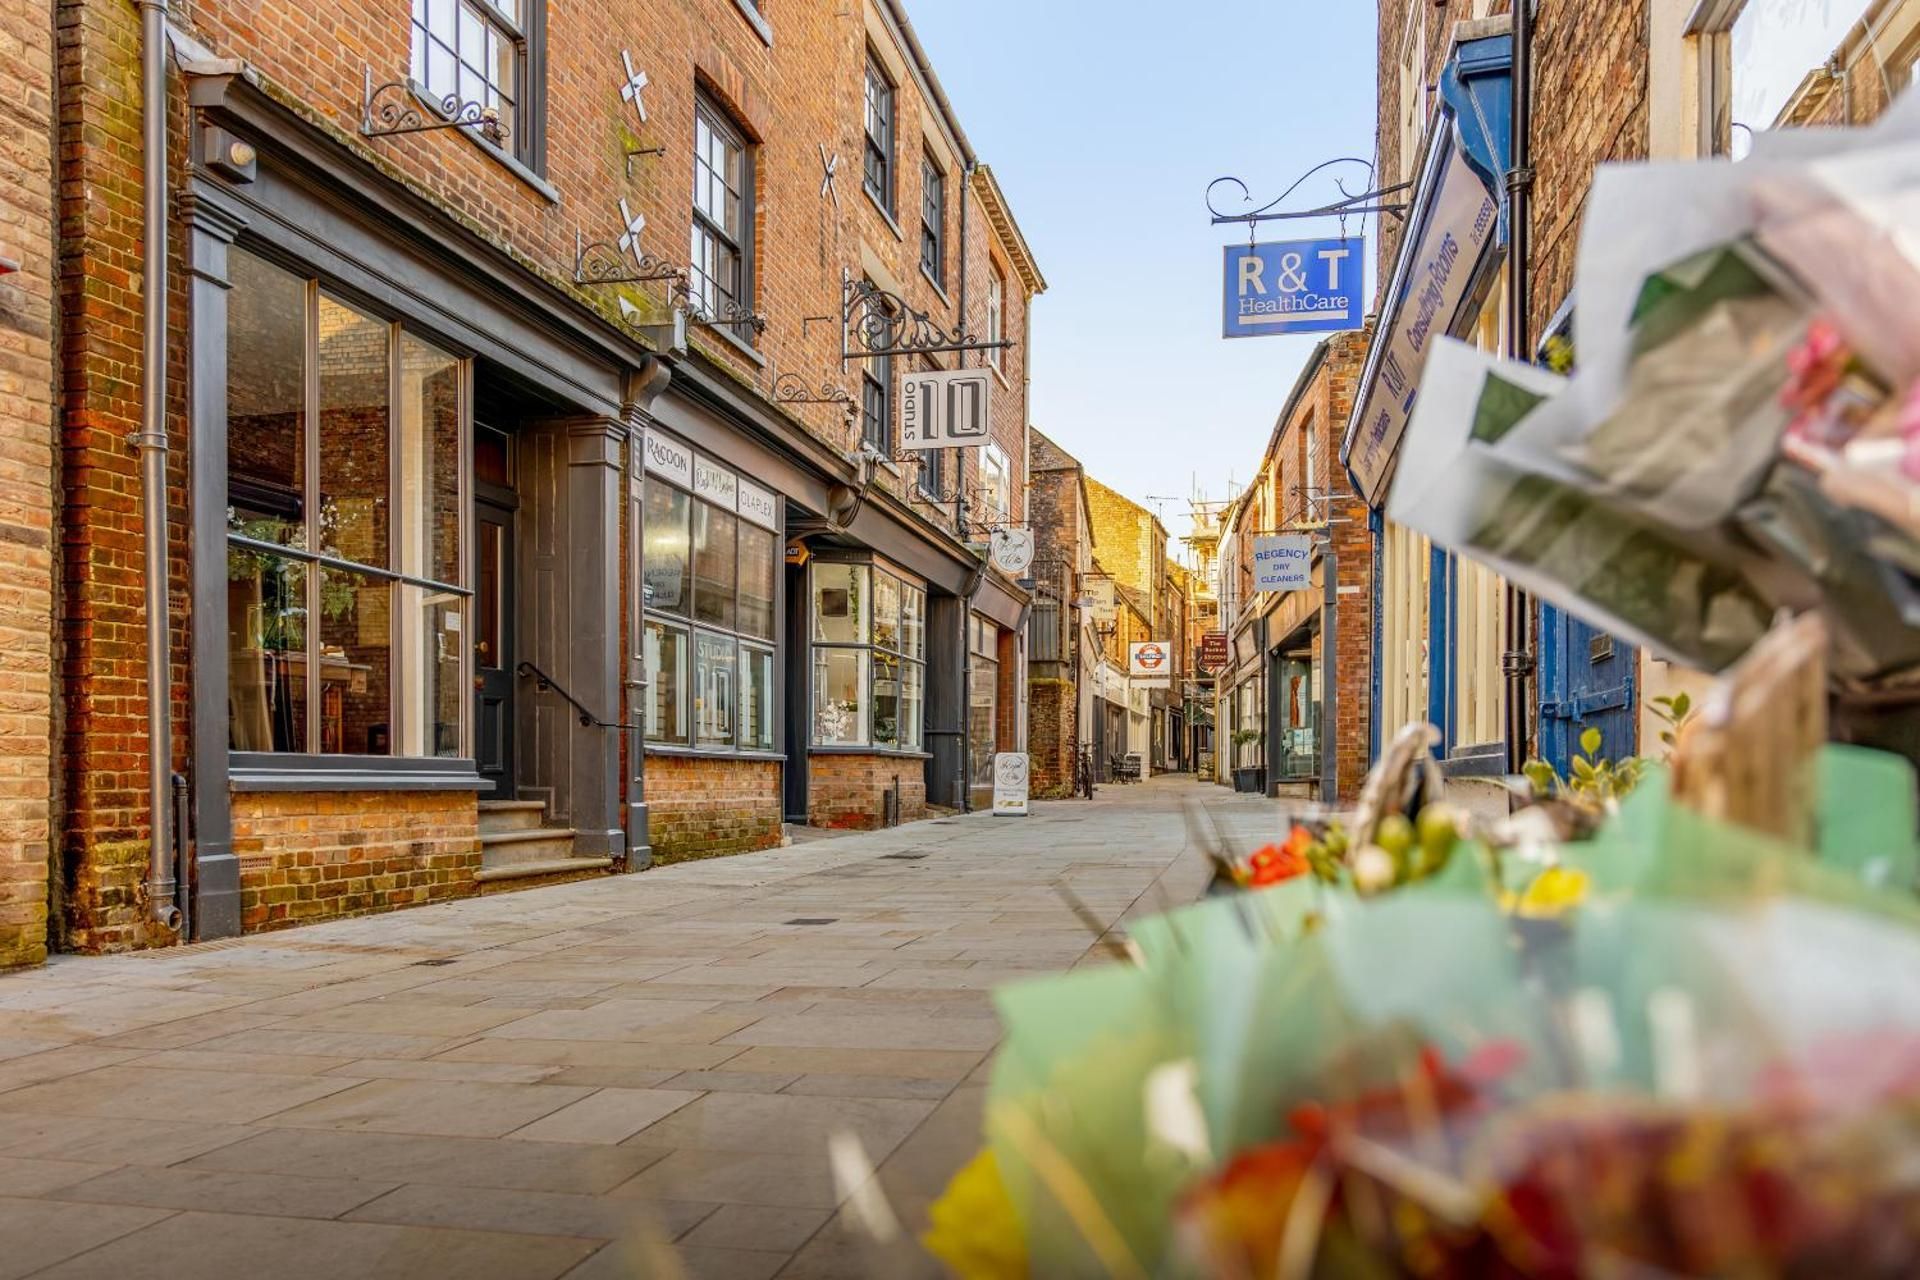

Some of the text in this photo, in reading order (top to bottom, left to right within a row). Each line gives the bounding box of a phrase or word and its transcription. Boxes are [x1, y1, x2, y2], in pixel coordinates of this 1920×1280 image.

[1238, 249, 1349, 296] R & T
[1239, 293, 1349, 315] HealthCare
[904, 381, 916, 441] STUDIO
[919, 377, 988, 440] 10
[647, 436, 688, 473] RACOON
[1255, 548, 1309, 561] REGENCY
[1273, 563, 1290, 571] DRY
[1261, 574, 1305, 583] CLEANERS
